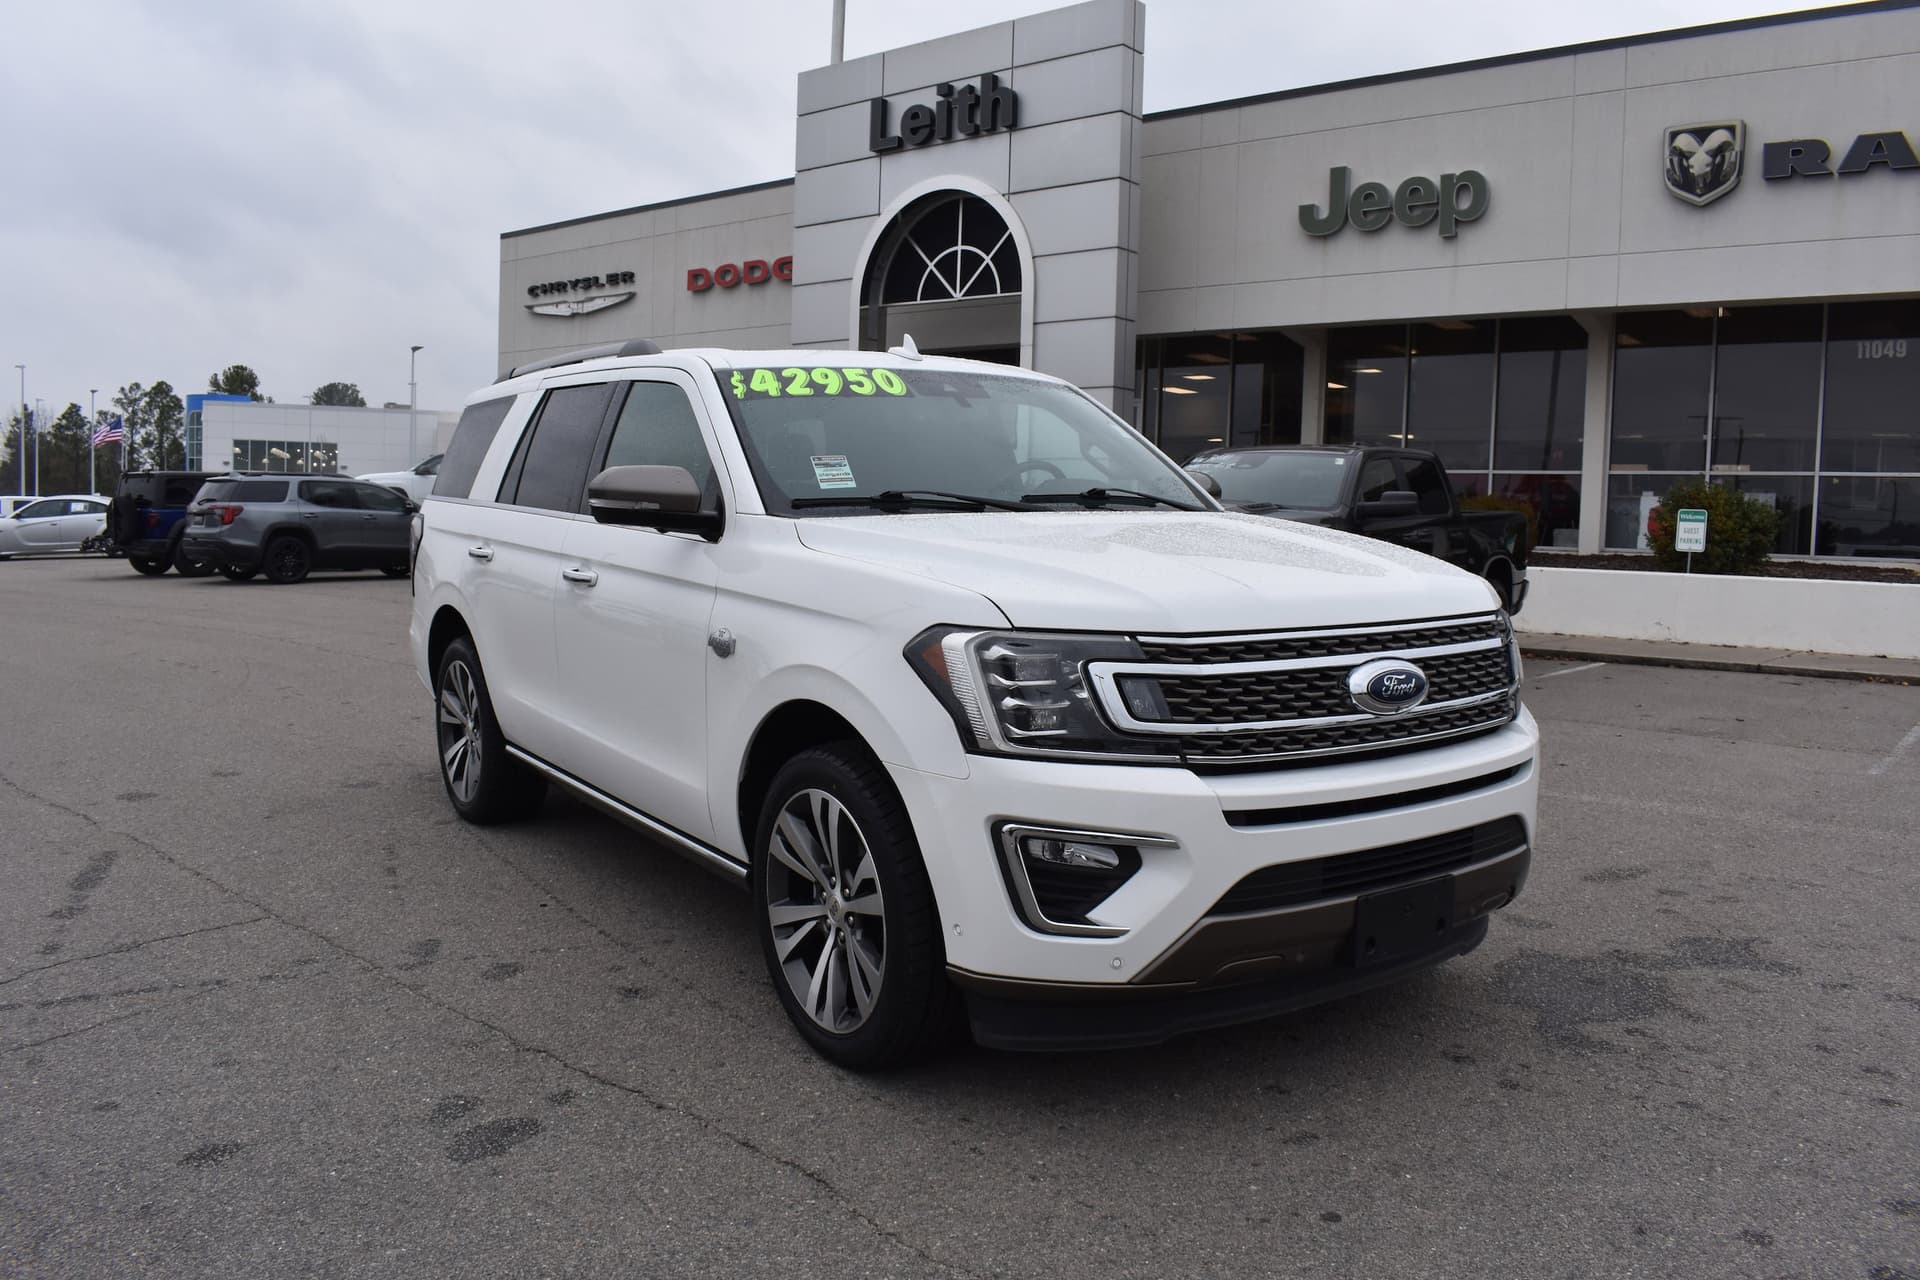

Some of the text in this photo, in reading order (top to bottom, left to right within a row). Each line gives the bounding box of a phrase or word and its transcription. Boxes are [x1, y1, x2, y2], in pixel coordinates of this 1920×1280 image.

[870, 72, 1018, 153] Leith
[1763, 130, 1920, 181] RA
[1298, 166, 1489, 238] Jeep
[528, 271, 635, 297] CHRYSLER
[687, 256, 793, 293] DODG
[1857, 339, 1907, 359] 11049
[730, 367, 907, 399] $42950
[1382, 674, 1416, 697] Ford
